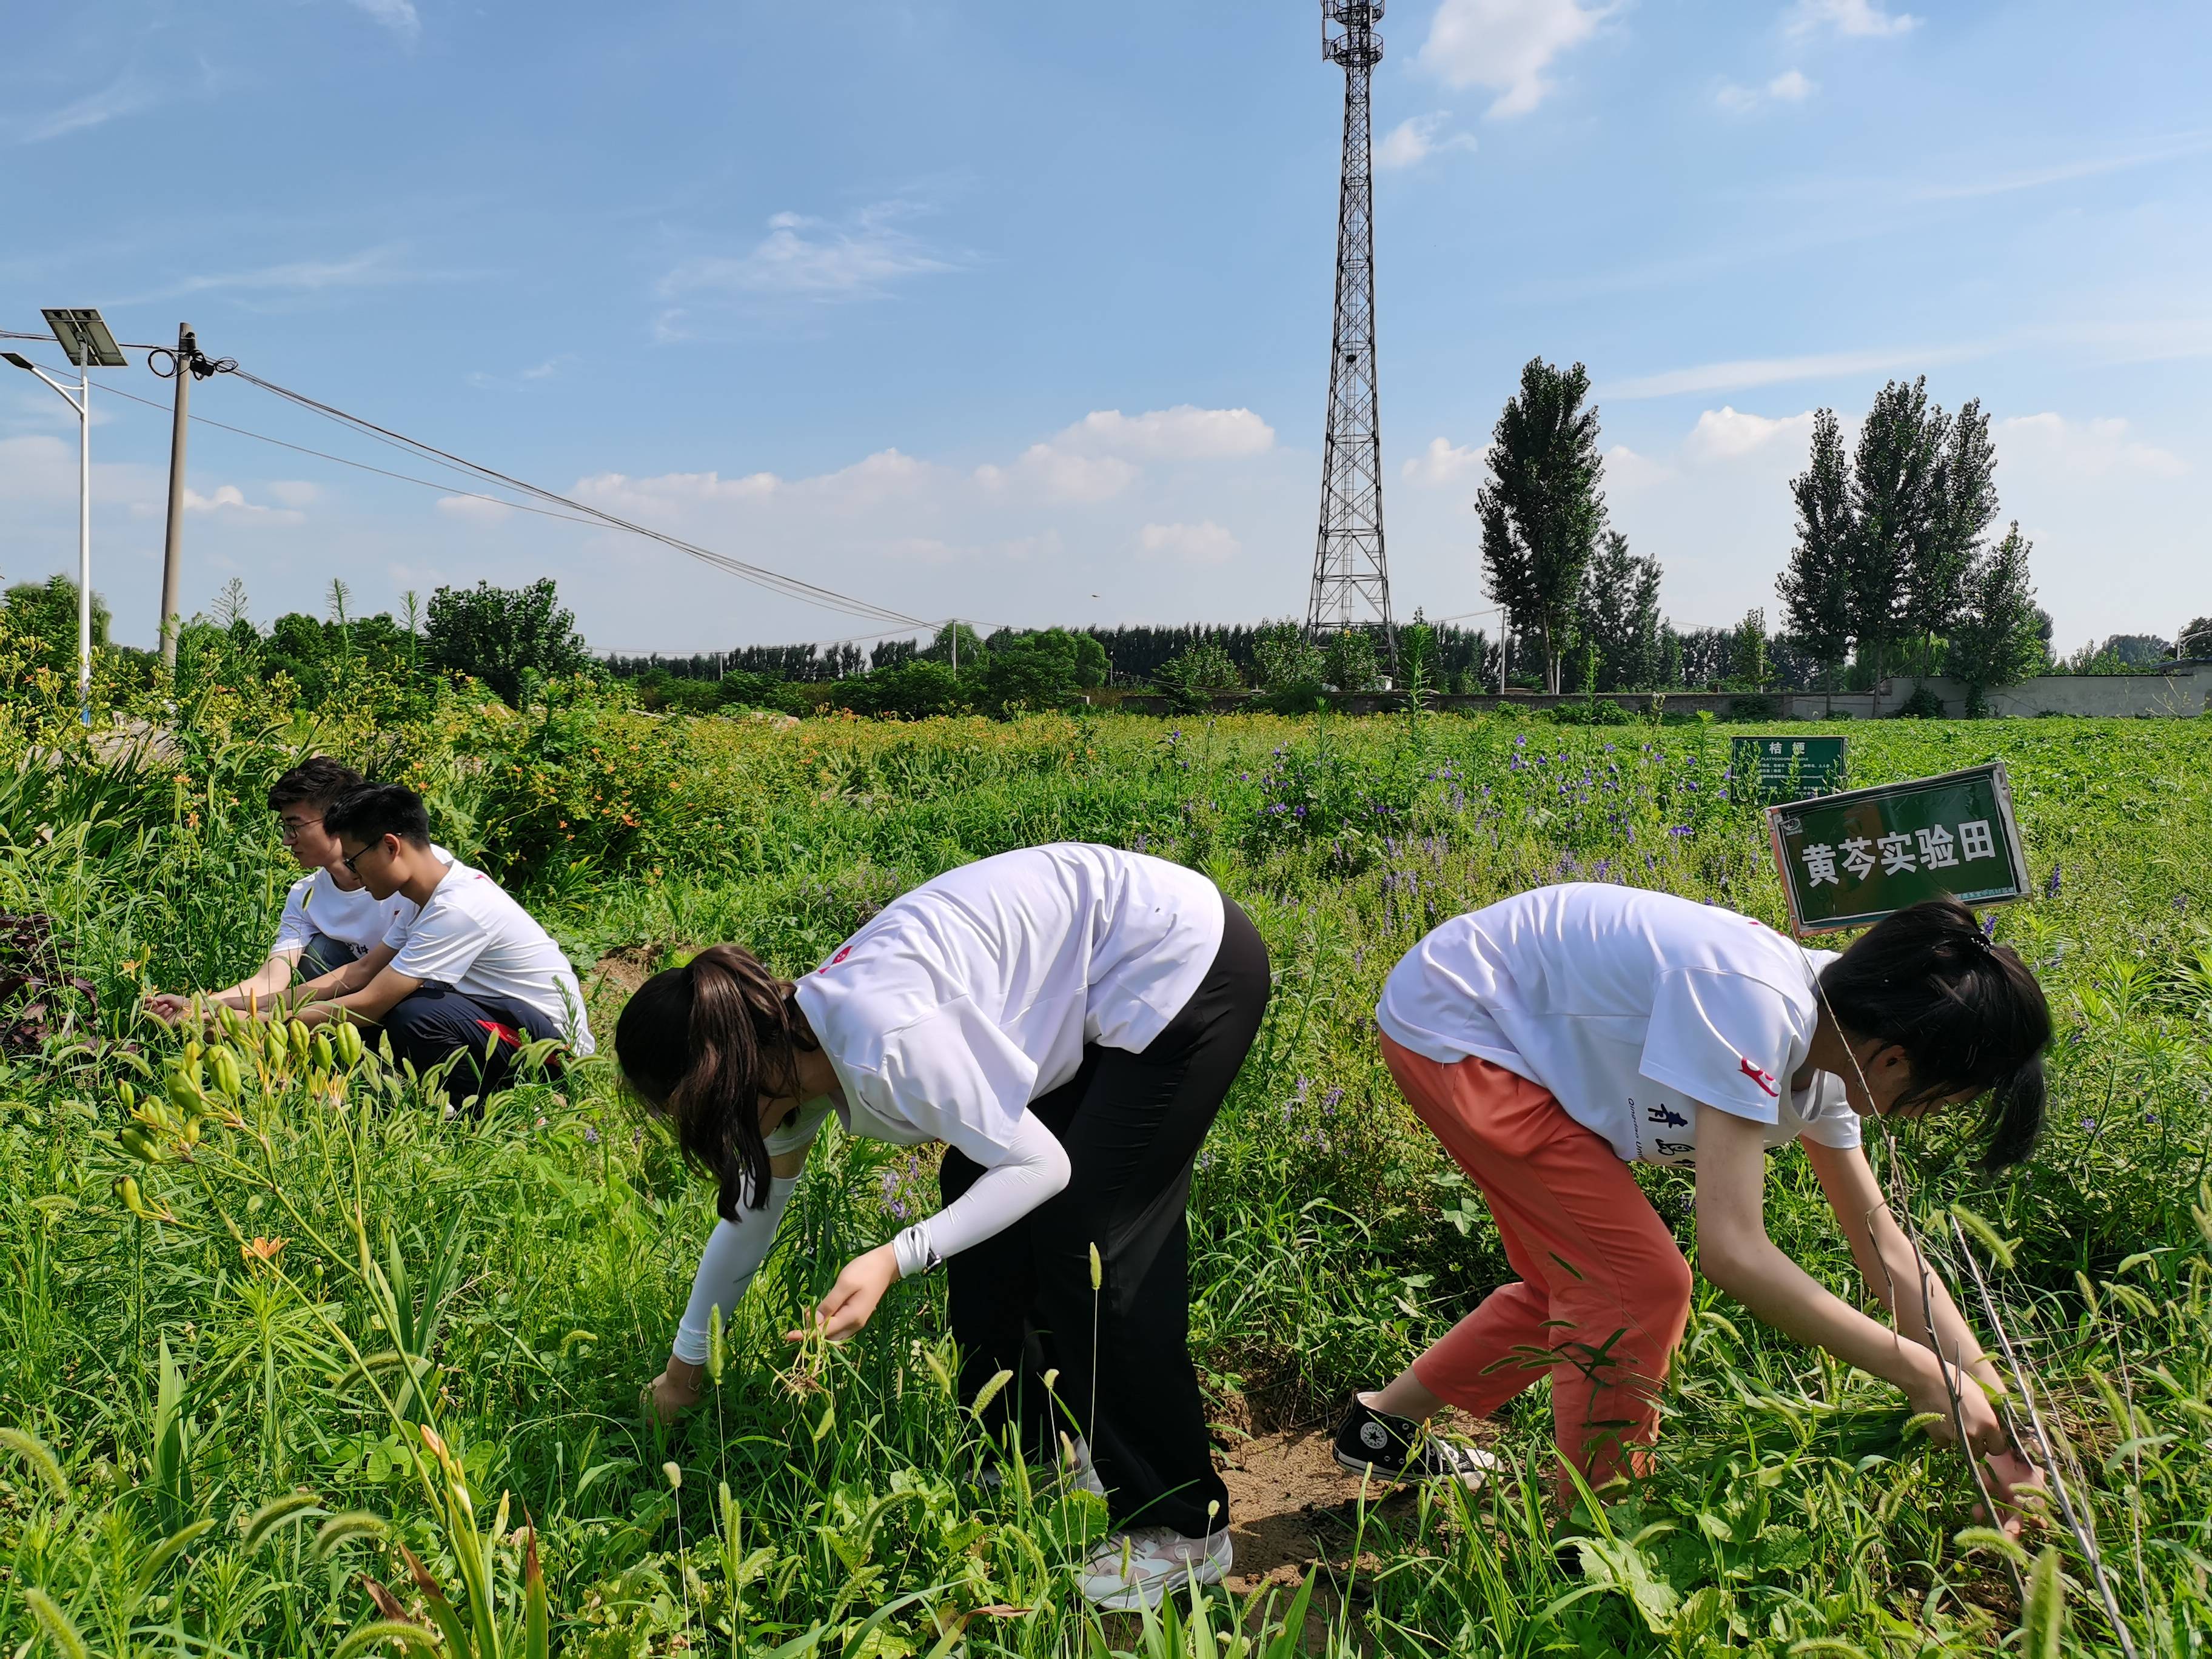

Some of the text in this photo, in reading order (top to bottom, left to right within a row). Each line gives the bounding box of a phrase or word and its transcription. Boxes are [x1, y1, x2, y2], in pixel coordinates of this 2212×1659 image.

[1801, 820, 1996, 888] 黄芩实验田
[1628, 1098, 1640, 1140] Qingdao
